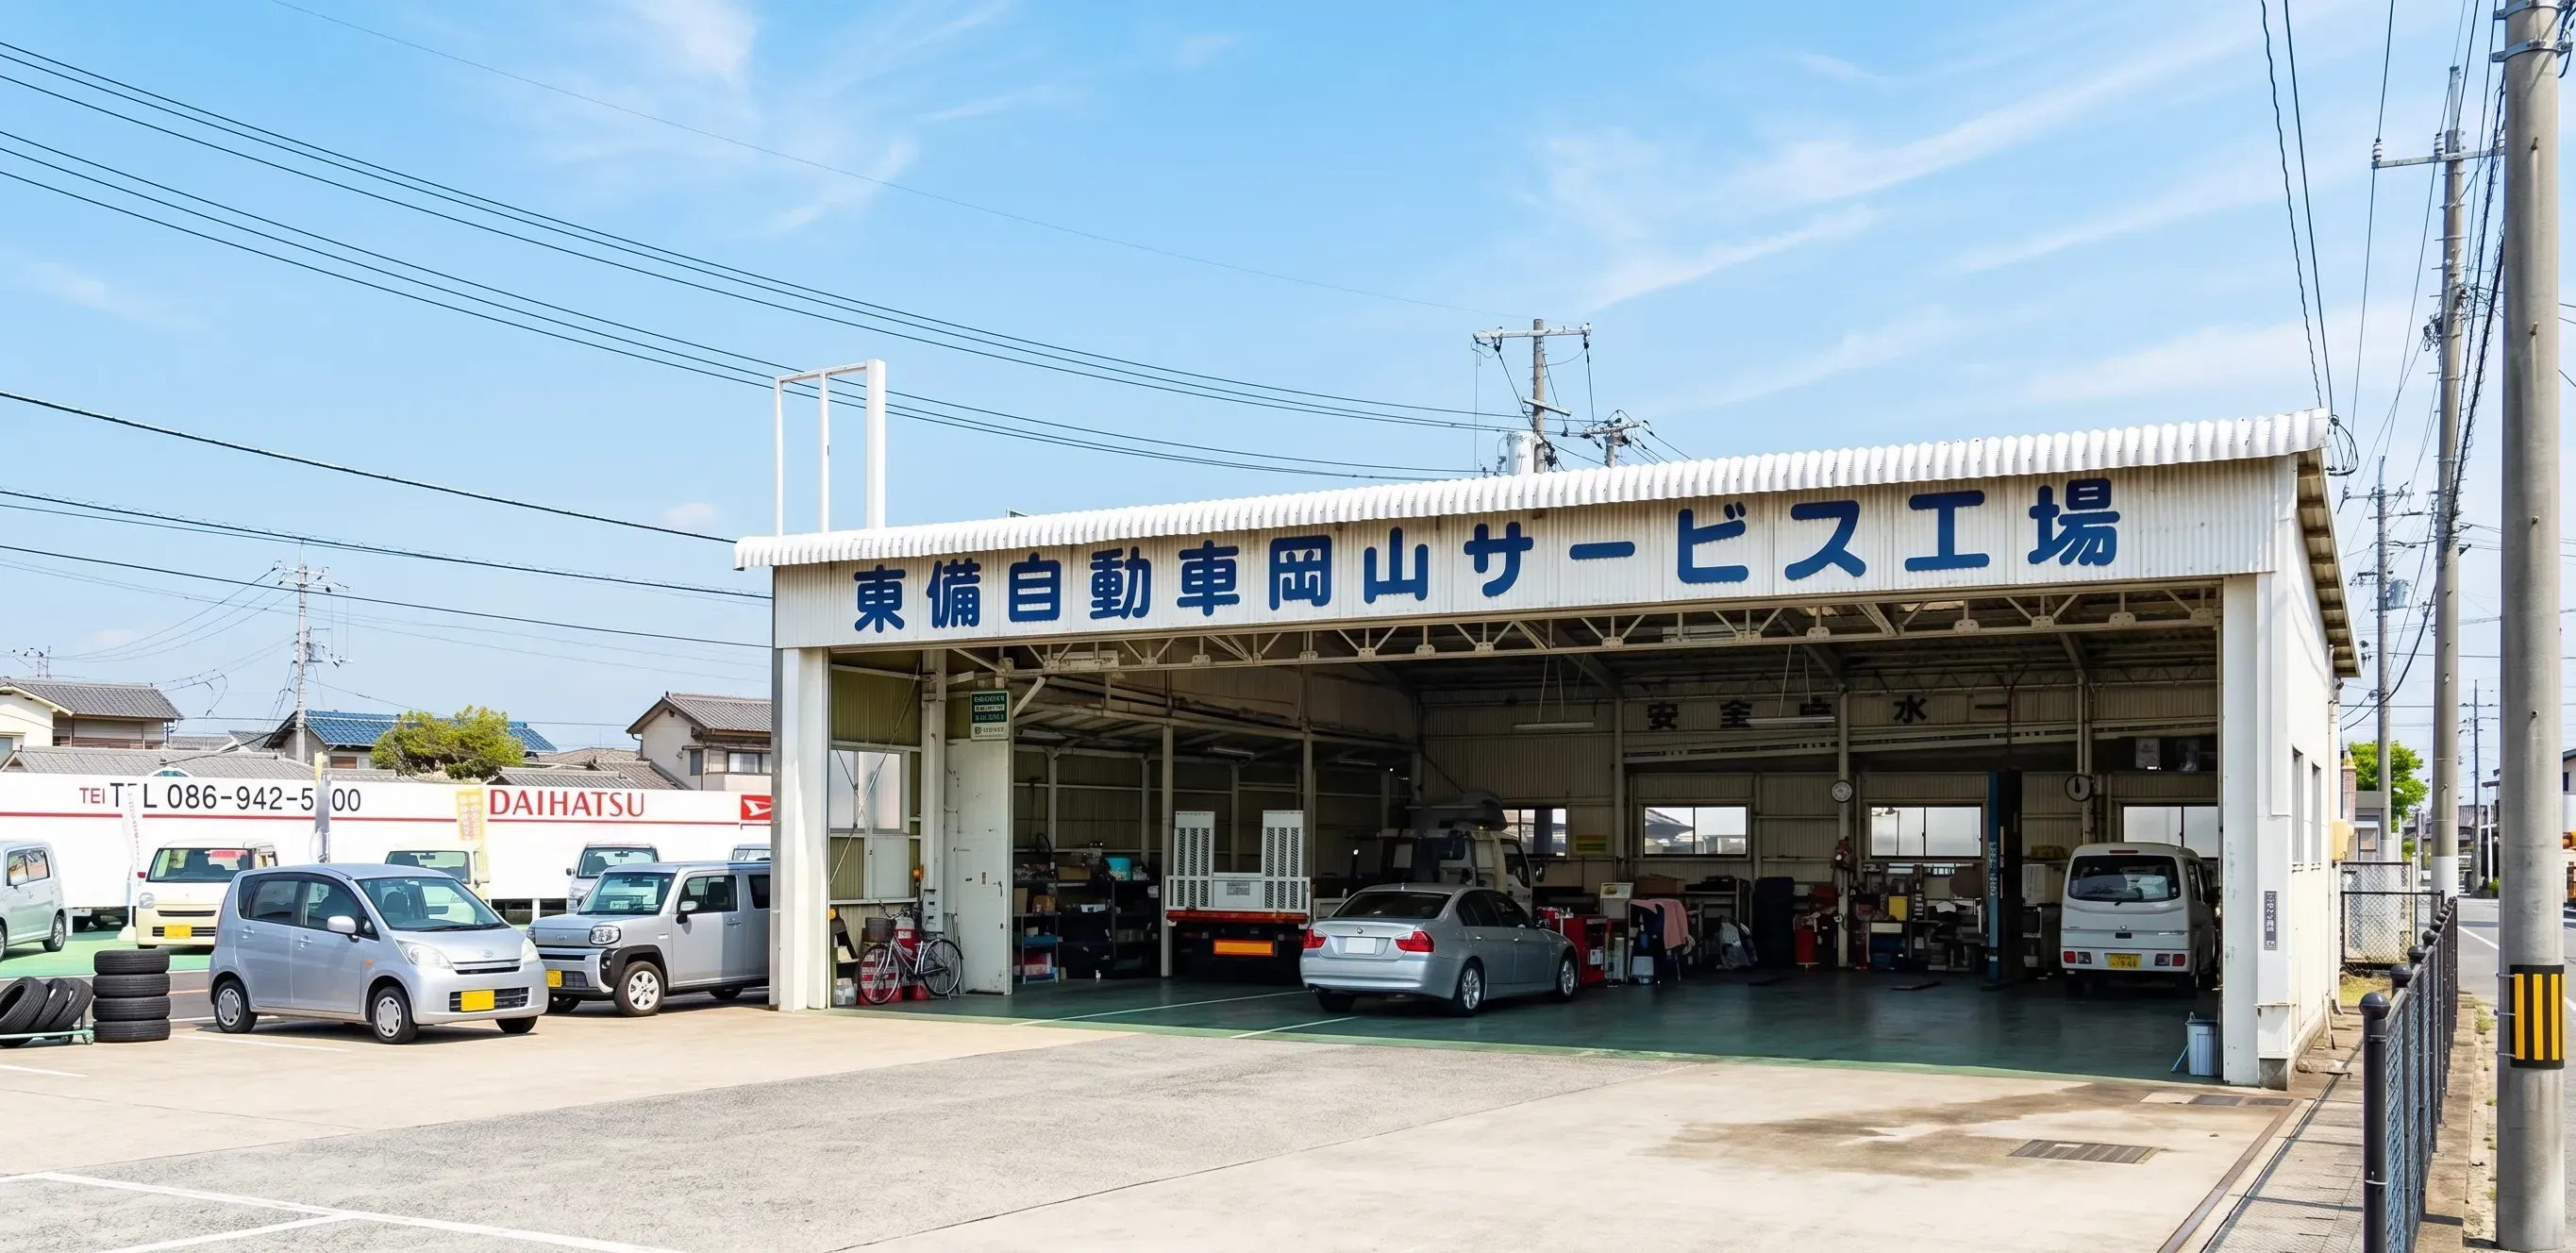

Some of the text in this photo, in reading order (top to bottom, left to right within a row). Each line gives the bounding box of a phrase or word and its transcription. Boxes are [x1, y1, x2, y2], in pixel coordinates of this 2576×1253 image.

[853, 477, 2121, 634] 東備自動車岡山サービス工場
[109, 782, 361, 812] TL 086-942-500
[489, 789, 644, 817] DAIHATSU
